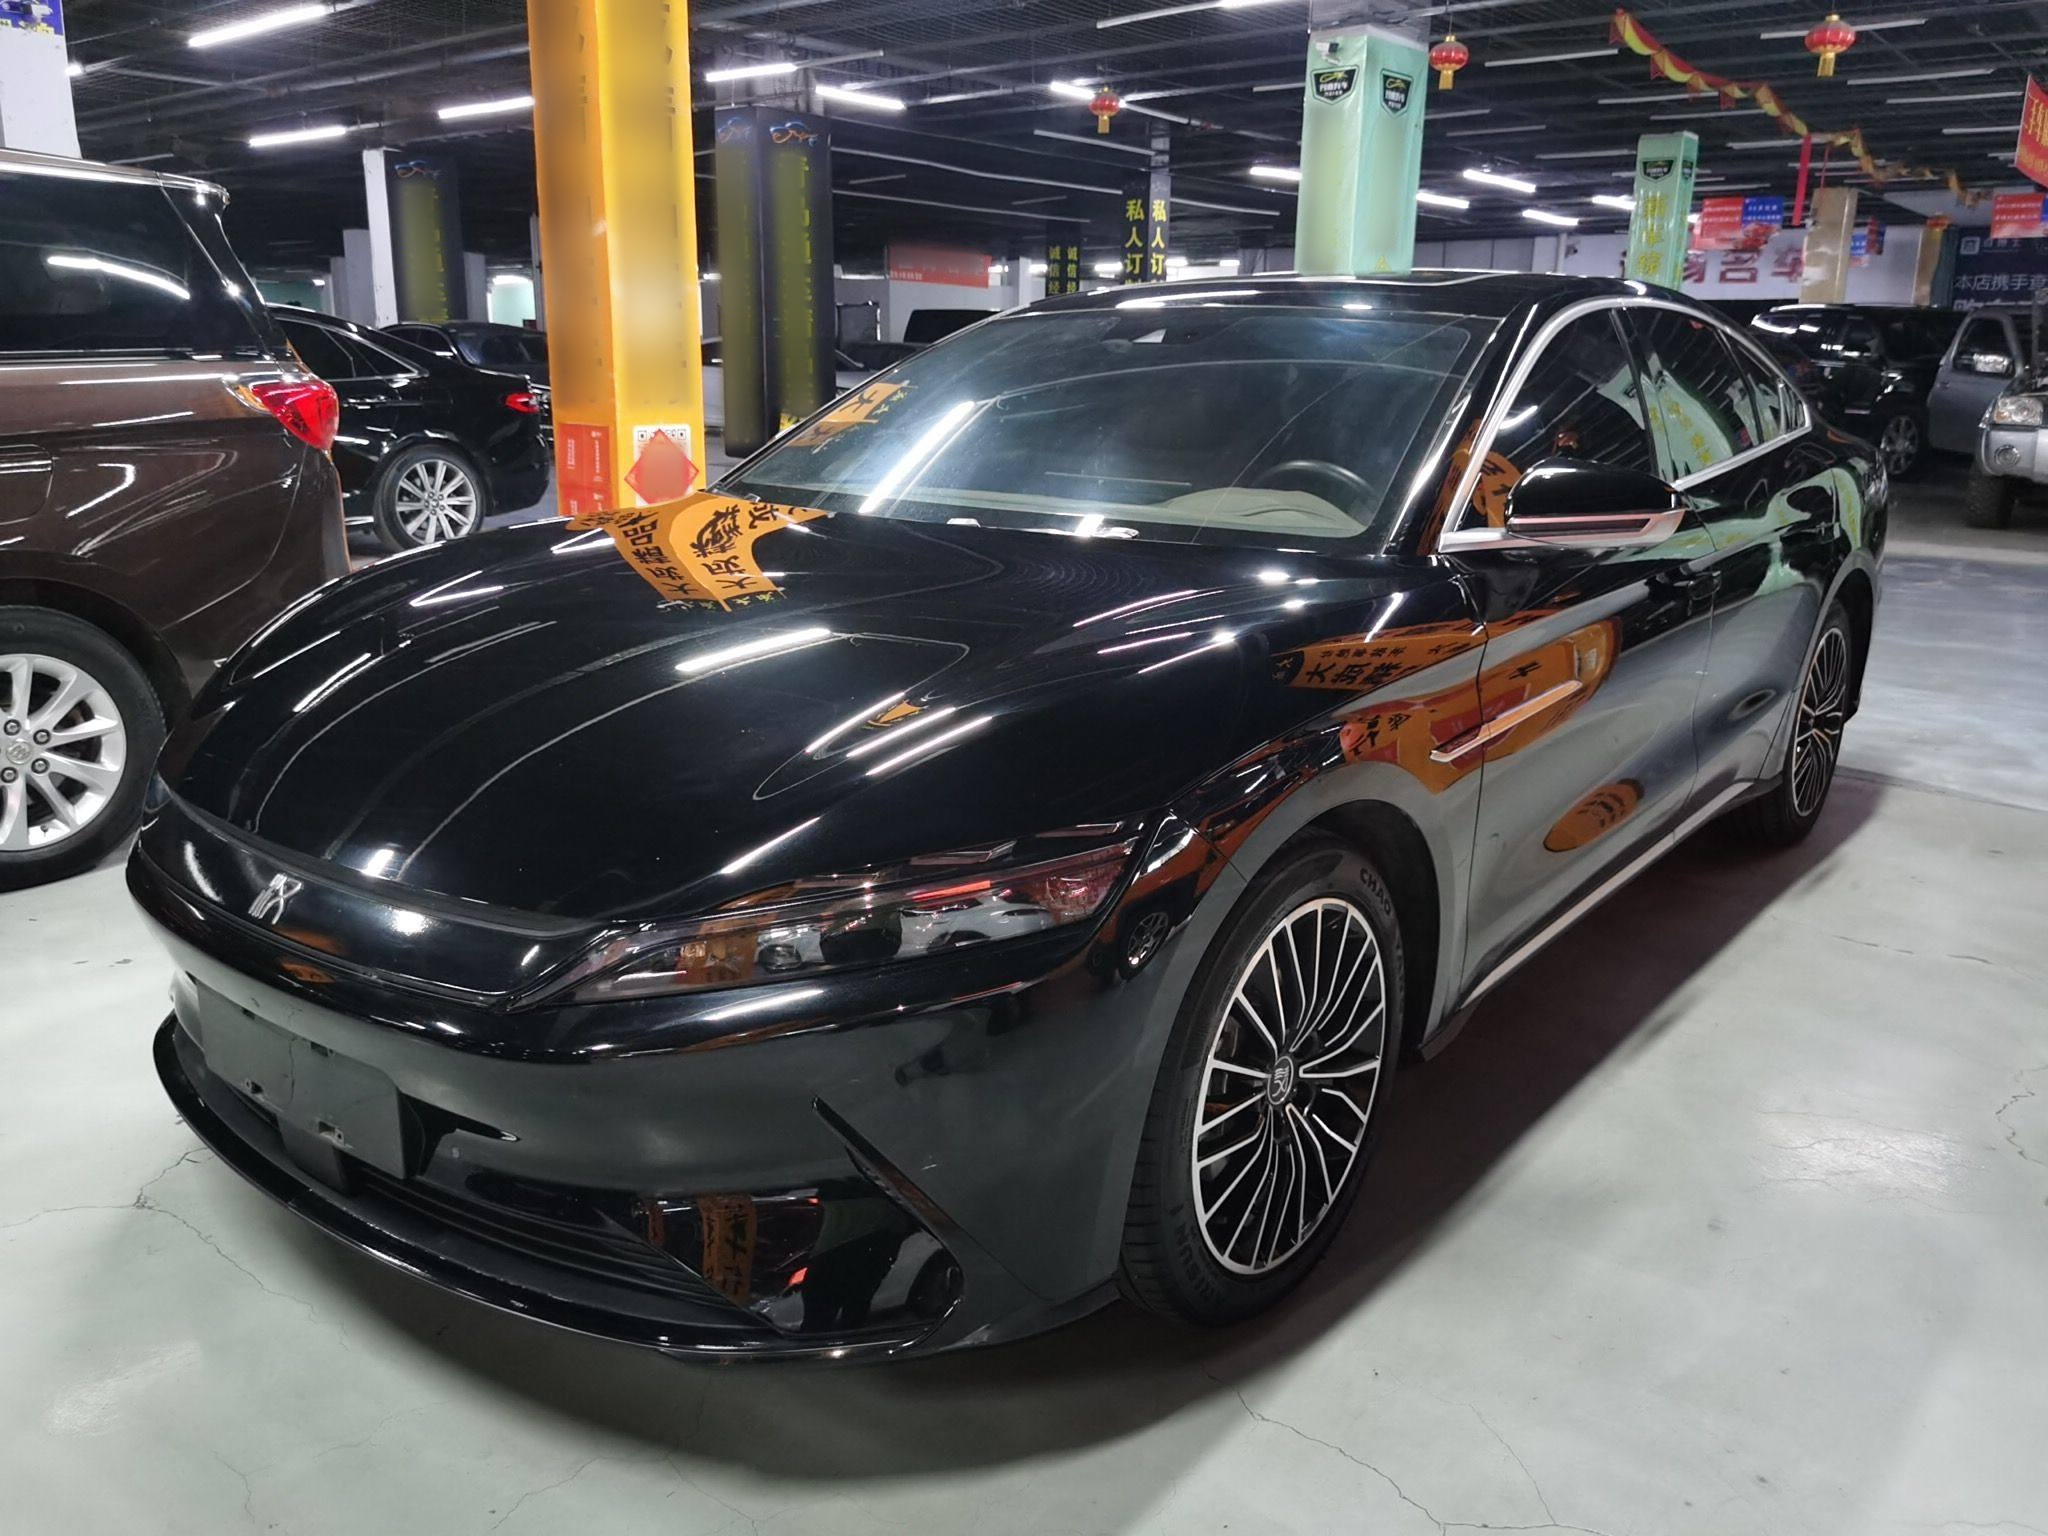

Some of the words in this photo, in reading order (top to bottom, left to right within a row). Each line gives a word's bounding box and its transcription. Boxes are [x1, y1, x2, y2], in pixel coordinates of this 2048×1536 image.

[1125, 199, 1145, 284] 私人订
[1151, 199, 1167, 283] 私人订
